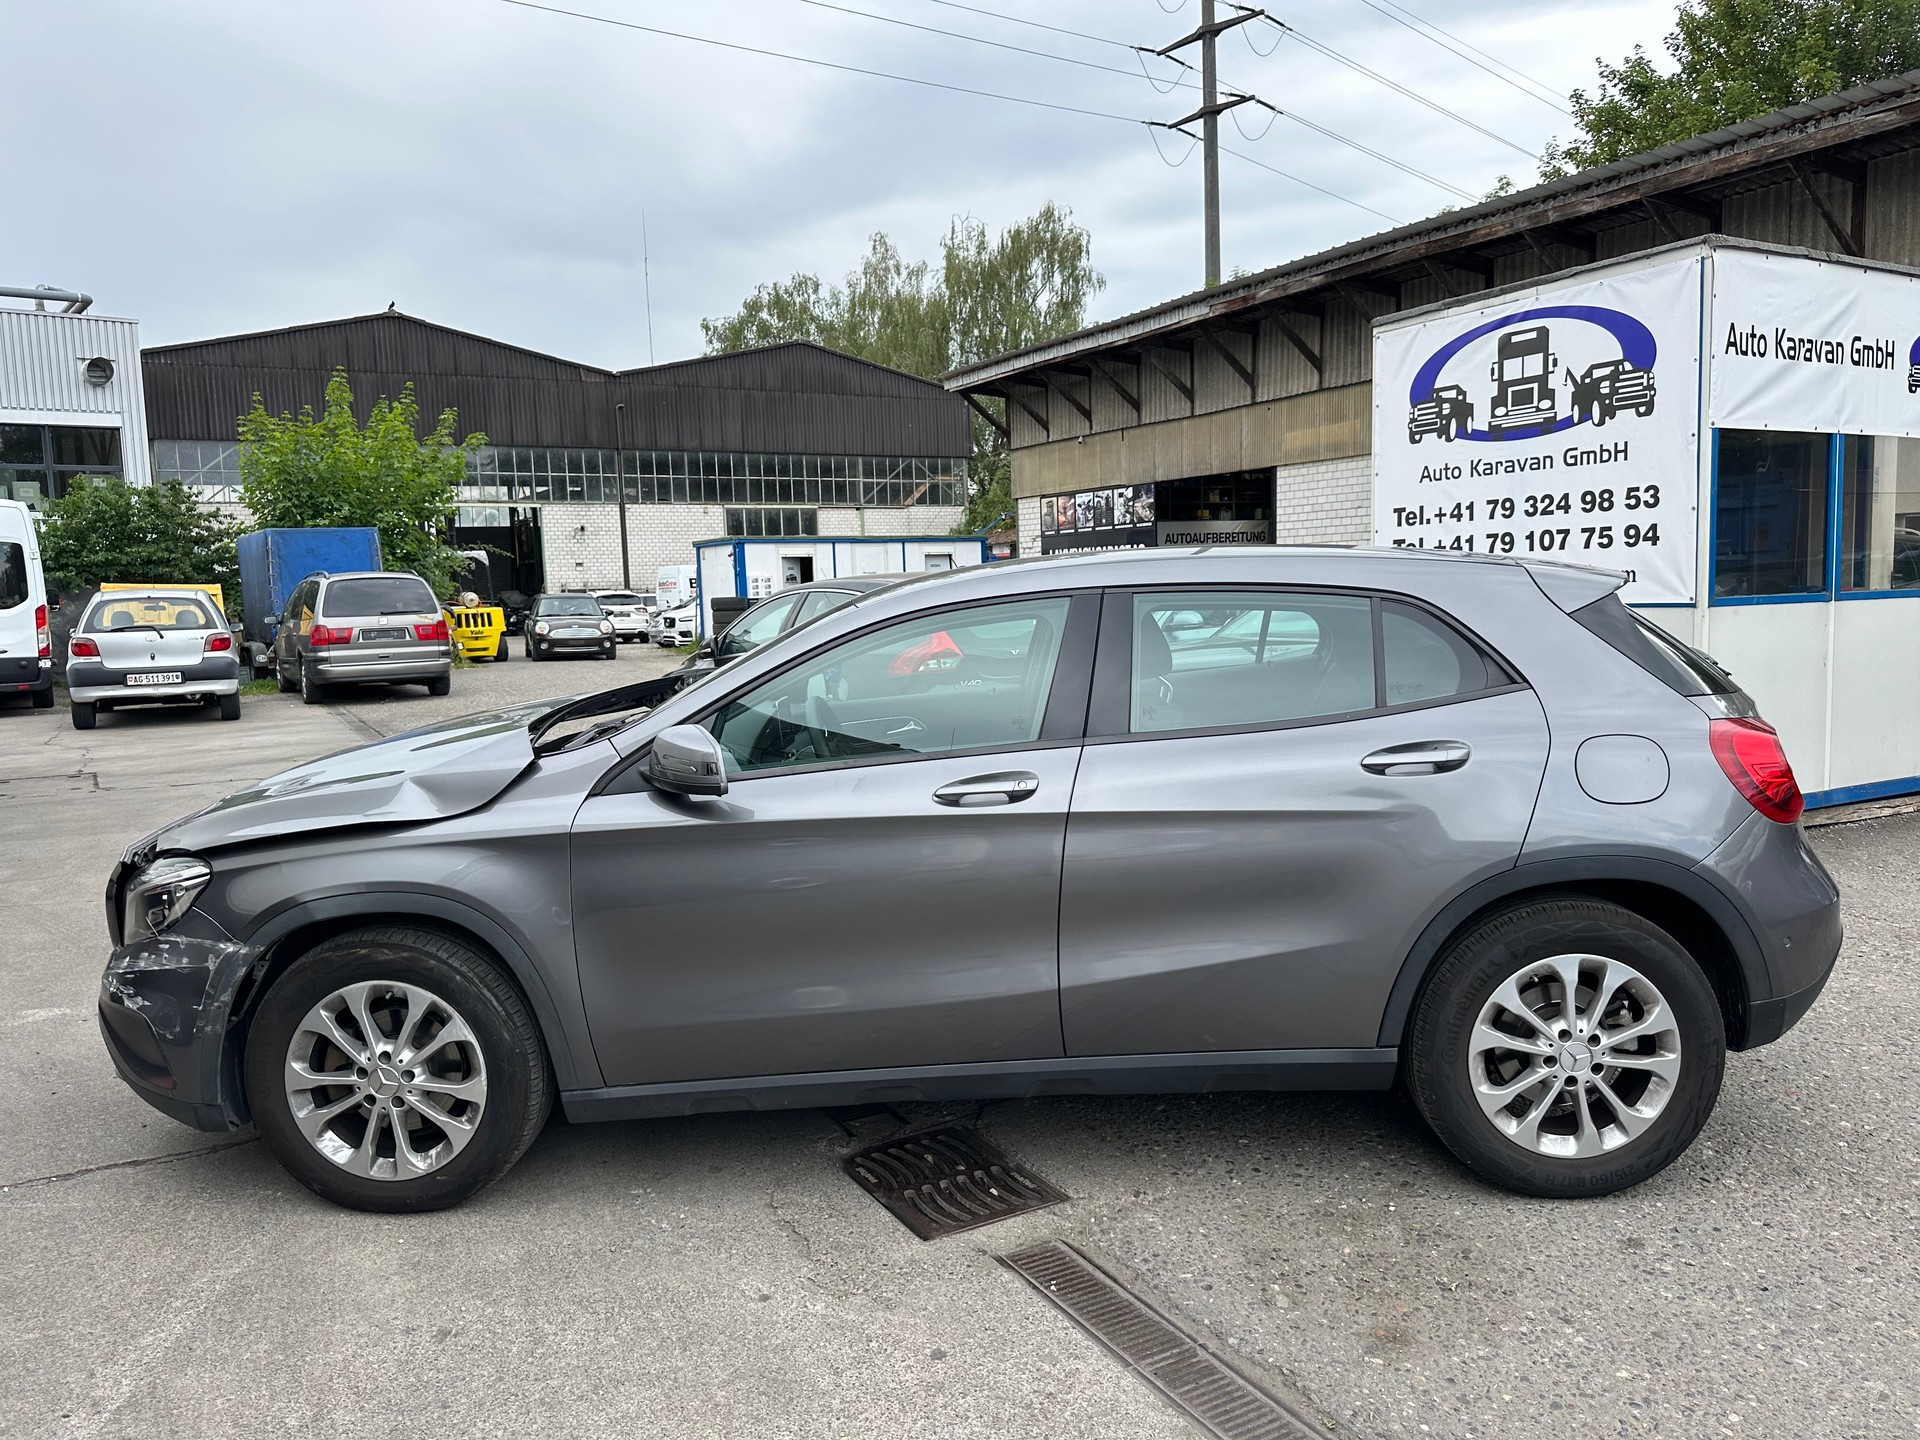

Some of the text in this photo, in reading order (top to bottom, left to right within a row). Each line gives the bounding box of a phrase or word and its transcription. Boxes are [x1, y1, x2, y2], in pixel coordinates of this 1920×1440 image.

[1724, 322, 1896, 371] Auto Karavan GmbH
[1419, 440, 1629, 483] Auto Karavan GmbH
[1485, 497, 1516, 520] 79
[1523, 492, 1572, 518] 324
[1580, 488, 1615, 513] 98
[1624, 484, 1661, 510] 53
[1164, 531, 1266, 545] AUTOAUFBEREITUNG
[1485, 532, 1515, 554] 79
[1524, 528, 1571, 552] 107
[1580, 525, 1614, 550] 75
[1623, 522, 1661, 548] 94
[960, 679, 982, 687] V40
[1442, 968, 1491, 1061] Continental
